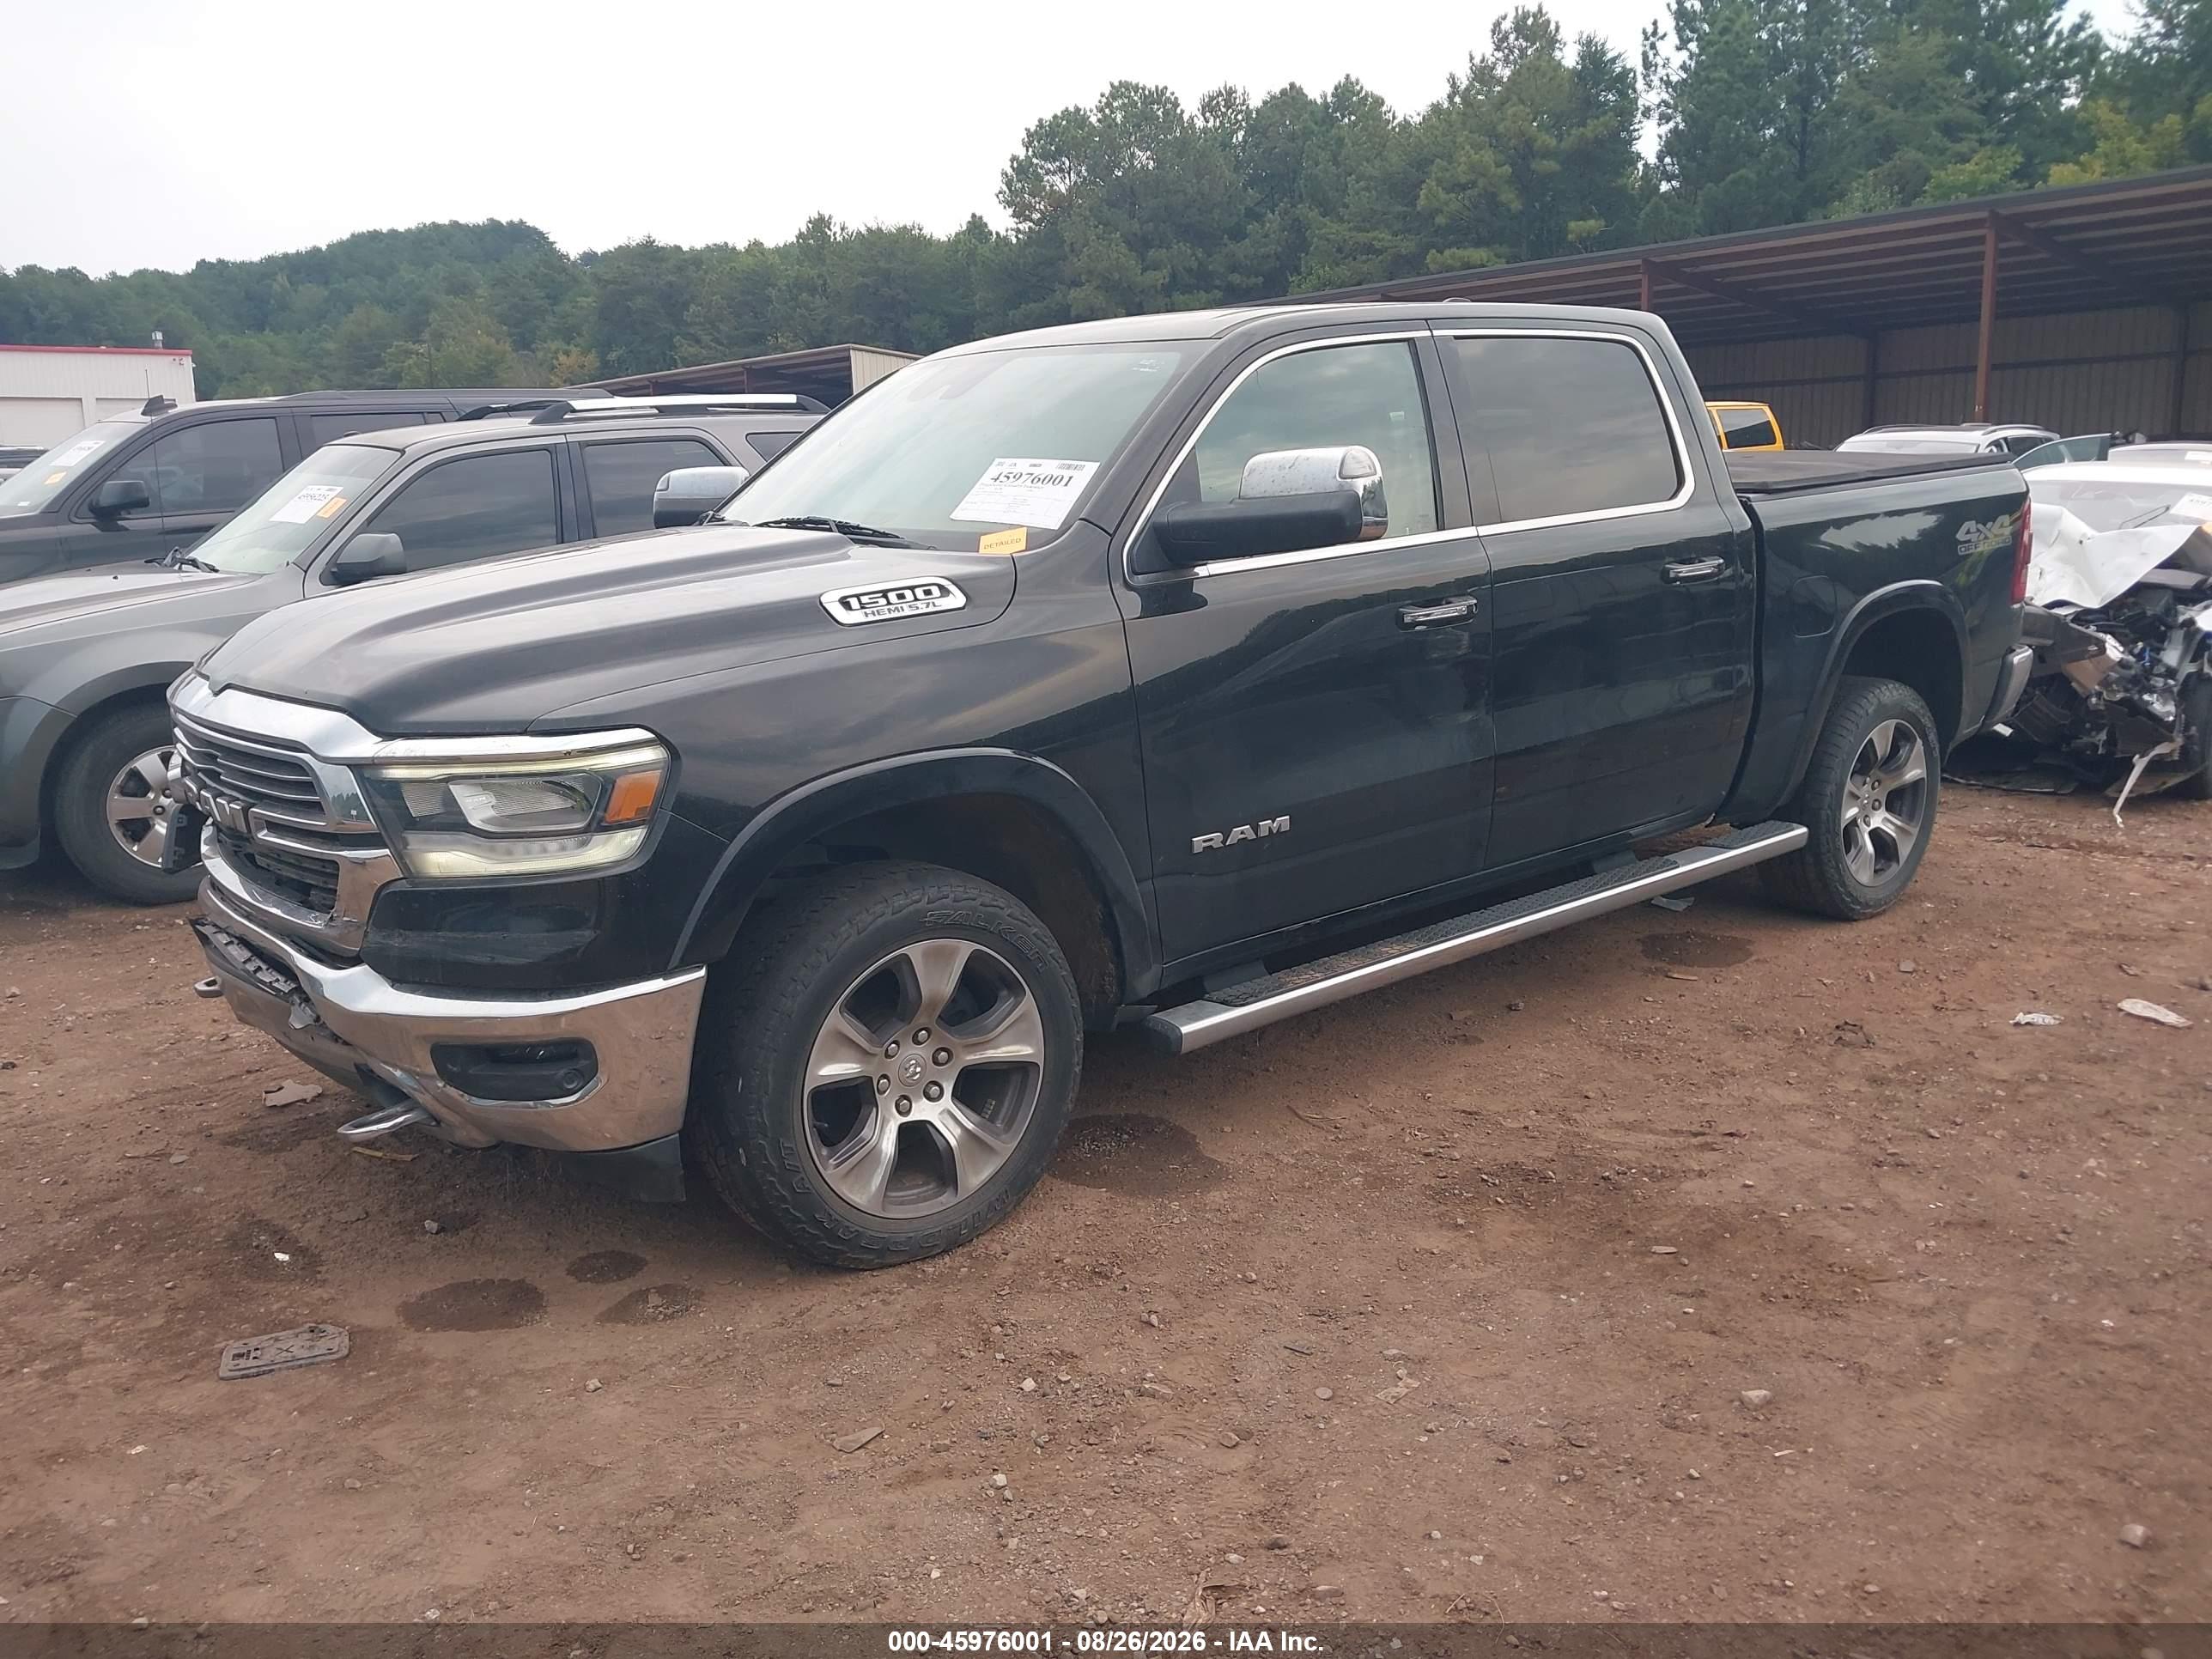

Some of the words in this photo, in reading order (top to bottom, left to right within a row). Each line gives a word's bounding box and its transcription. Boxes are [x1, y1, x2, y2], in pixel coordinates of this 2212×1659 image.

[990, 471, 1074, 487] 45976001
[983, 537, 1022, 550] DETAILED
[1959, 544, 1979, 555] OFF
[844, 584, 942, 611] 1500
[863, 605, 905, 618] HEMI
[908, 601, 943, 613] 5.7L
[1192, 815, 1290, 854] RAM
[920, 910, 1048, 975] FALKEN
